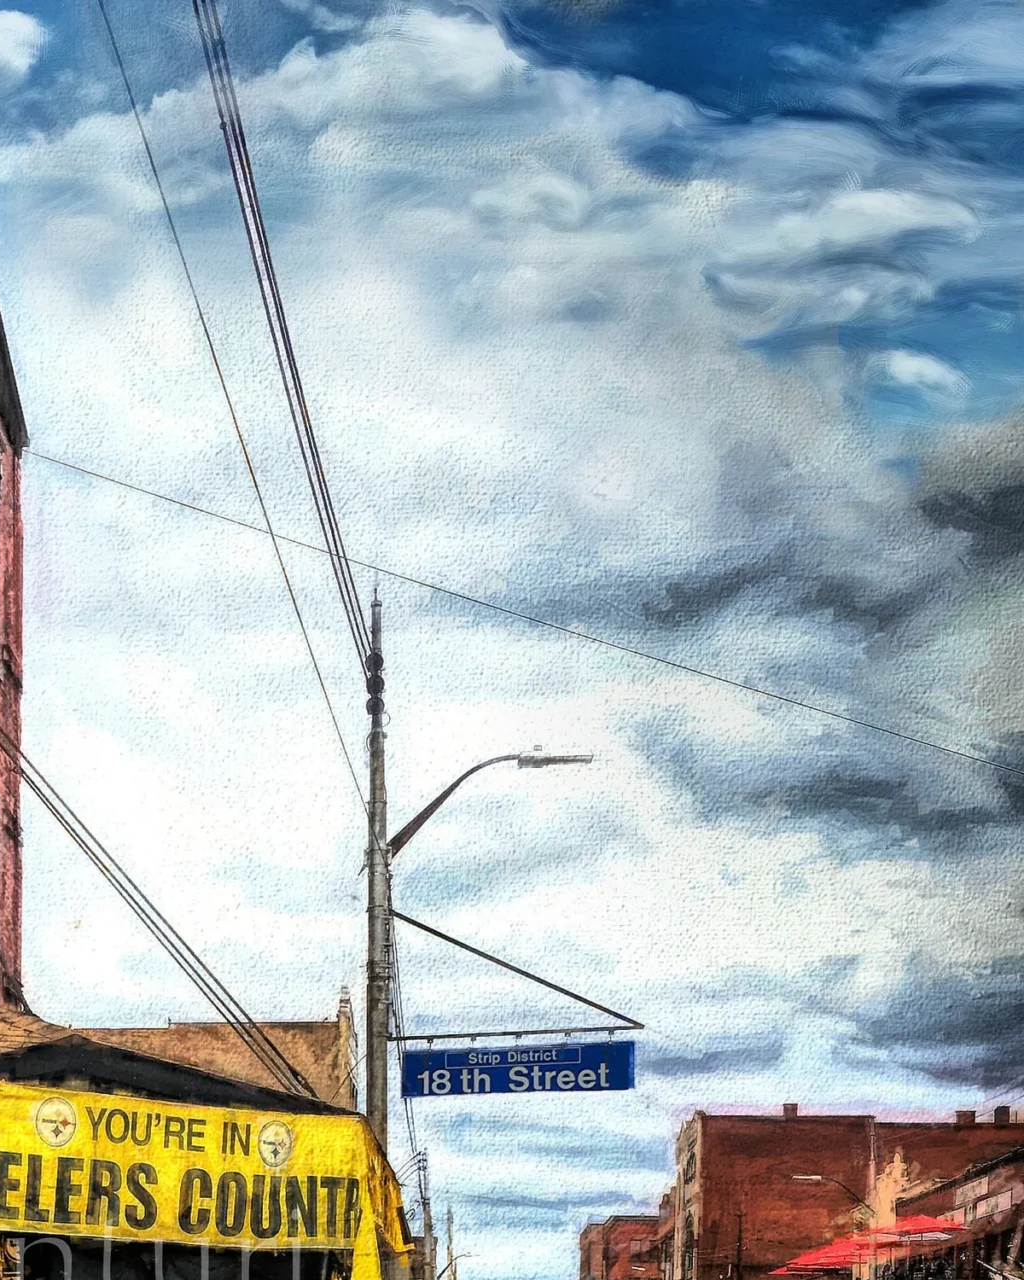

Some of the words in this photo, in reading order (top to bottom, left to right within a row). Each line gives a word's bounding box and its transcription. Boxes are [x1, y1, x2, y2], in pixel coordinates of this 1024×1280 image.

[467, 1052, 501, 1066] Strip
[507, 1050, 557, 1063] District
[417, 1069, 451, 1095] 18
[460, 1068, 491, 1093] th
[508, 1062, 610, 1092] Street
[85, 1106, 207, 1152] YOU'RE
[221, 1121, 251, 1157] IN
